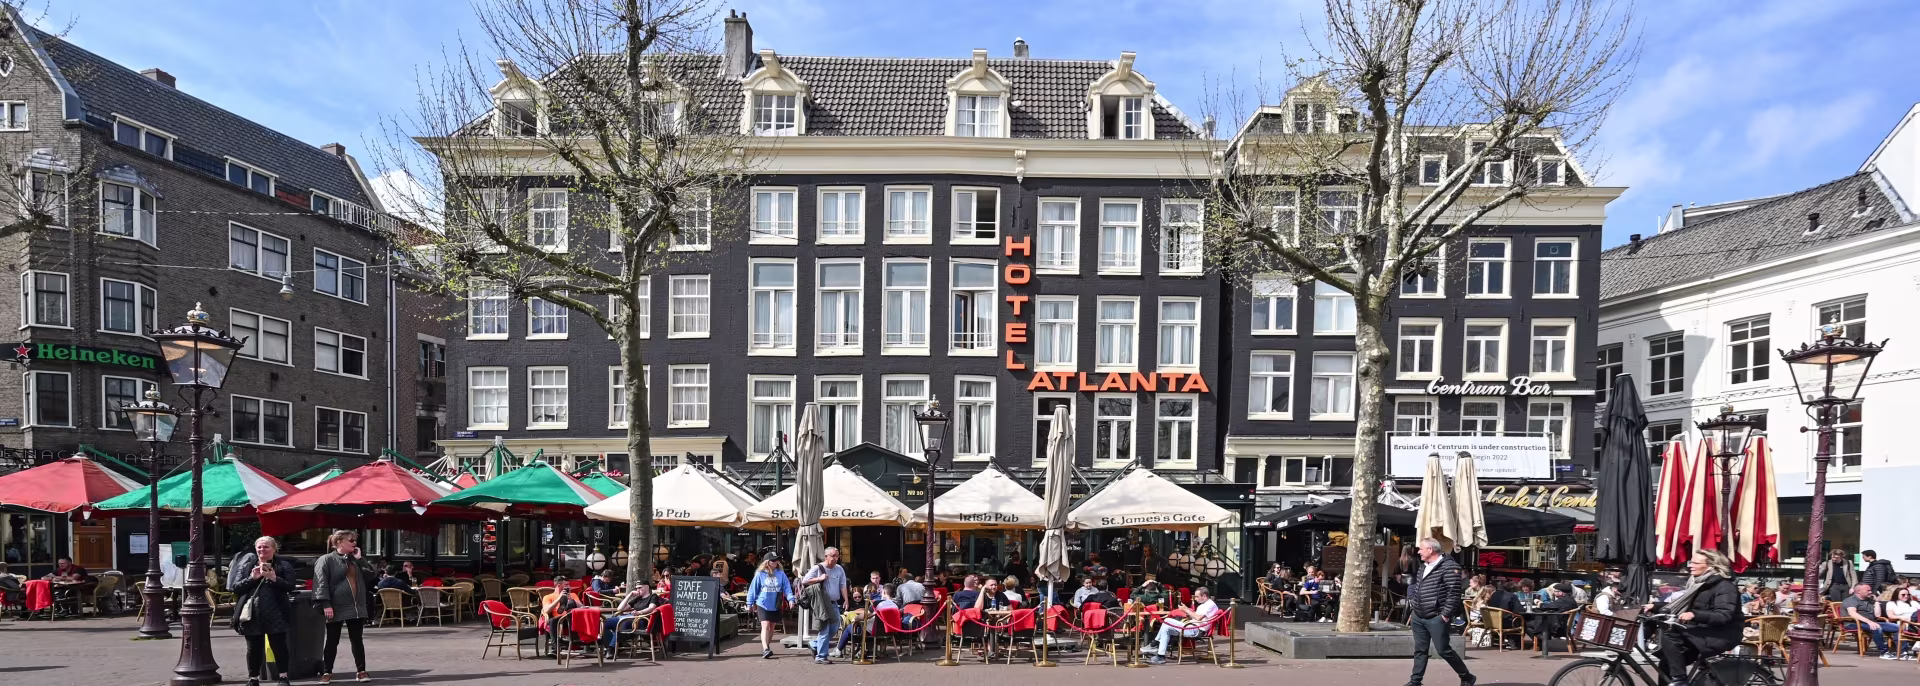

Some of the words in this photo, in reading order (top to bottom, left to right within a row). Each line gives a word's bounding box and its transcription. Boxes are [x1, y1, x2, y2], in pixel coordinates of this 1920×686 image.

[1004, 235, 1031, 370] HOTEL
[36, 343, 156, 369] Heineken
[1027, 371, 1210, 393] ATLANTA
[1426, 375, 1507, 395] Centrum
[1509, 375, 1552, 396] Bar
[1478, 443, 1500, 451] under
[1500, 443, 1547, 451] construction
[666, 508, 691, 518] Pub
[841, 507, 874, 517] Gate
[959, 512, 992, 522] Irish
[994, 512, 1019, 523] Pub
[1172, 512, 1206, 523] Gate
[678, 580, 702, 591] STAFF
[676, 591, 709, 600] WANTED
